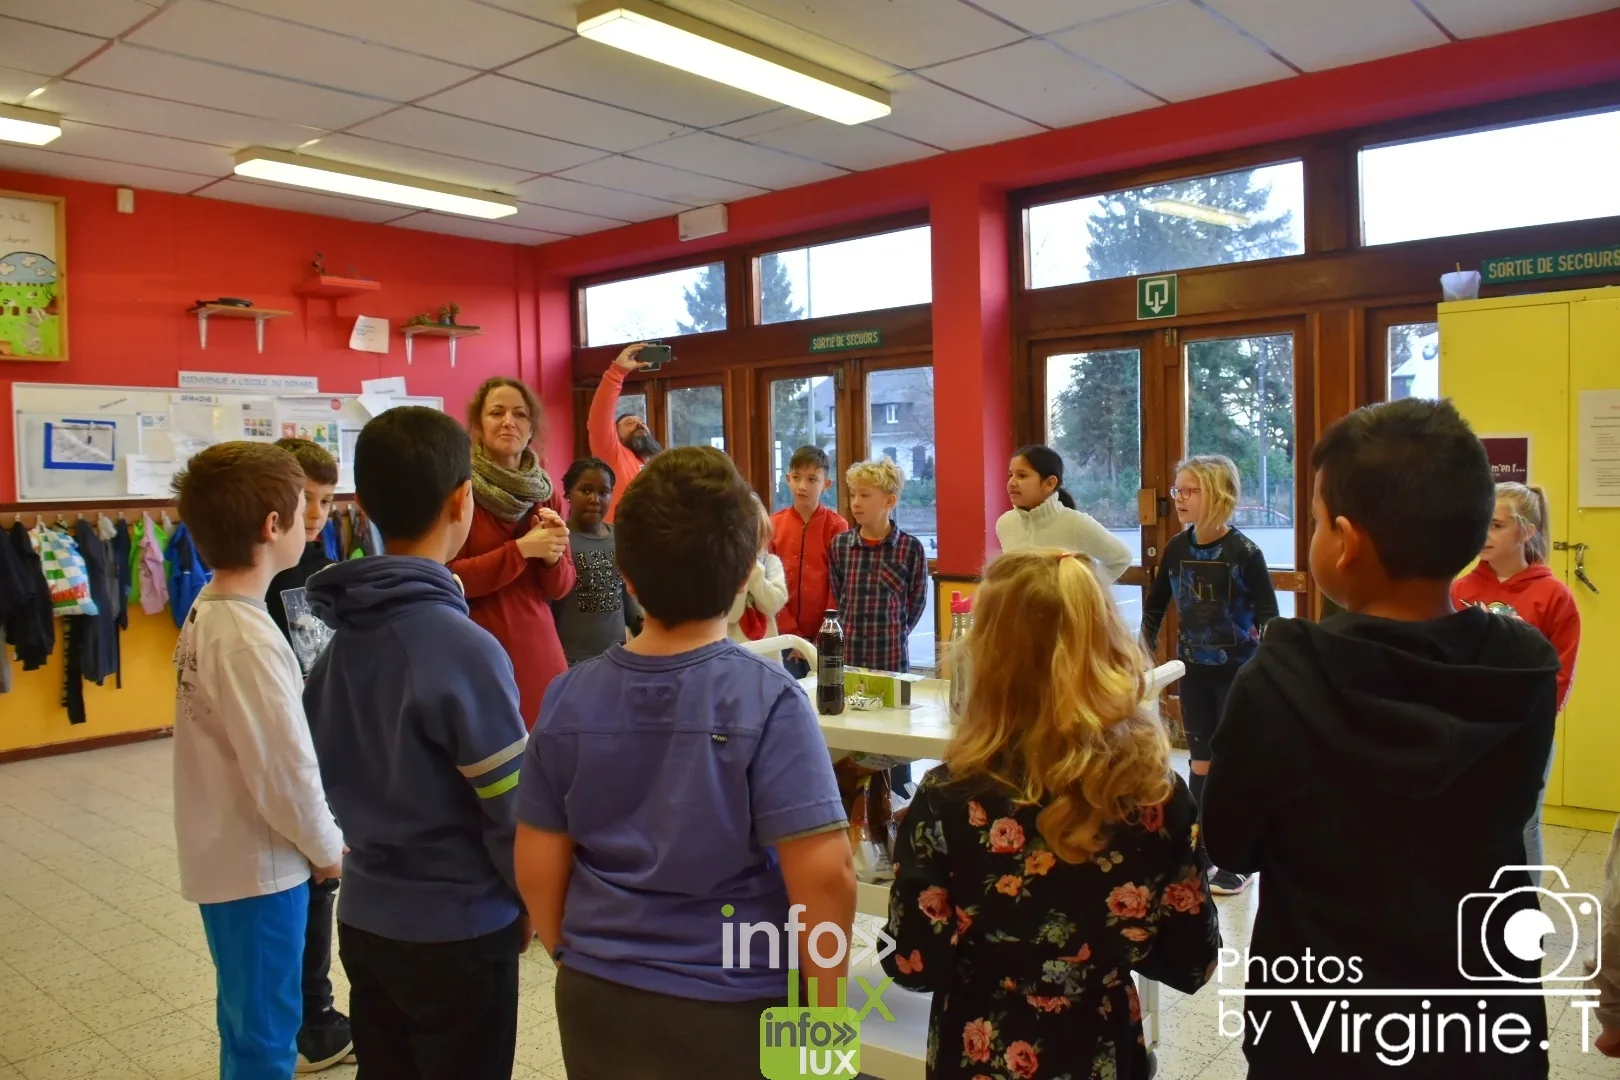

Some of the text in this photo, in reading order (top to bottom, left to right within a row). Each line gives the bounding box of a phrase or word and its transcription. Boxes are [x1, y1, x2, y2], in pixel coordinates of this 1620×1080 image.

[1488, 249, 1620, 279] SORTIE DE SECOURS
[812, 331, 878, 350] SORTIE DE SECOURS
[181, 376, 229, 386] BIENVENUE
